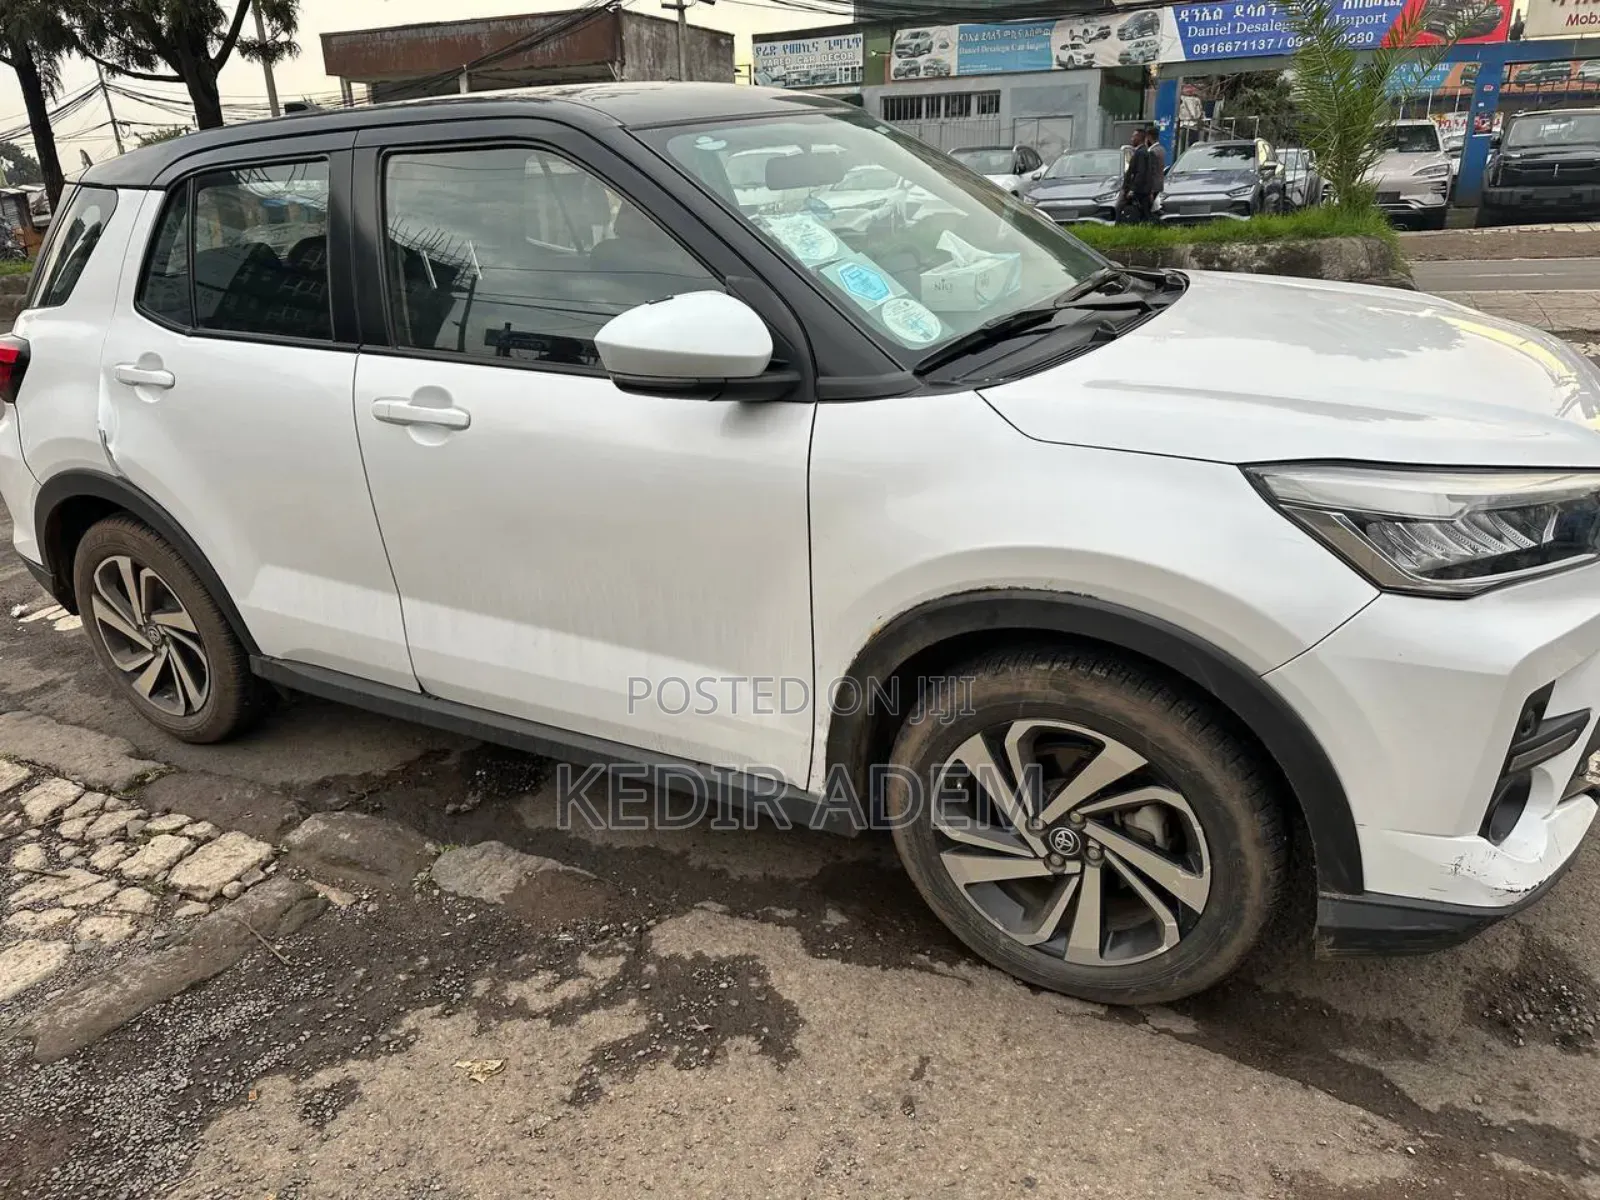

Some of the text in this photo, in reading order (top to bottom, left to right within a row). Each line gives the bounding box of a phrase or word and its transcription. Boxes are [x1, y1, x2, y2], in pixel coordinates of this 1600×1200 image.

[1566, 12, 1600, 27] Mob
[1188, 23, 1231, 37] Daniel
[1193, 38, 1275, 55] 0916671137
[797, 55, 816, 64] CAR
[822, 52, 856, 62] DECOR
